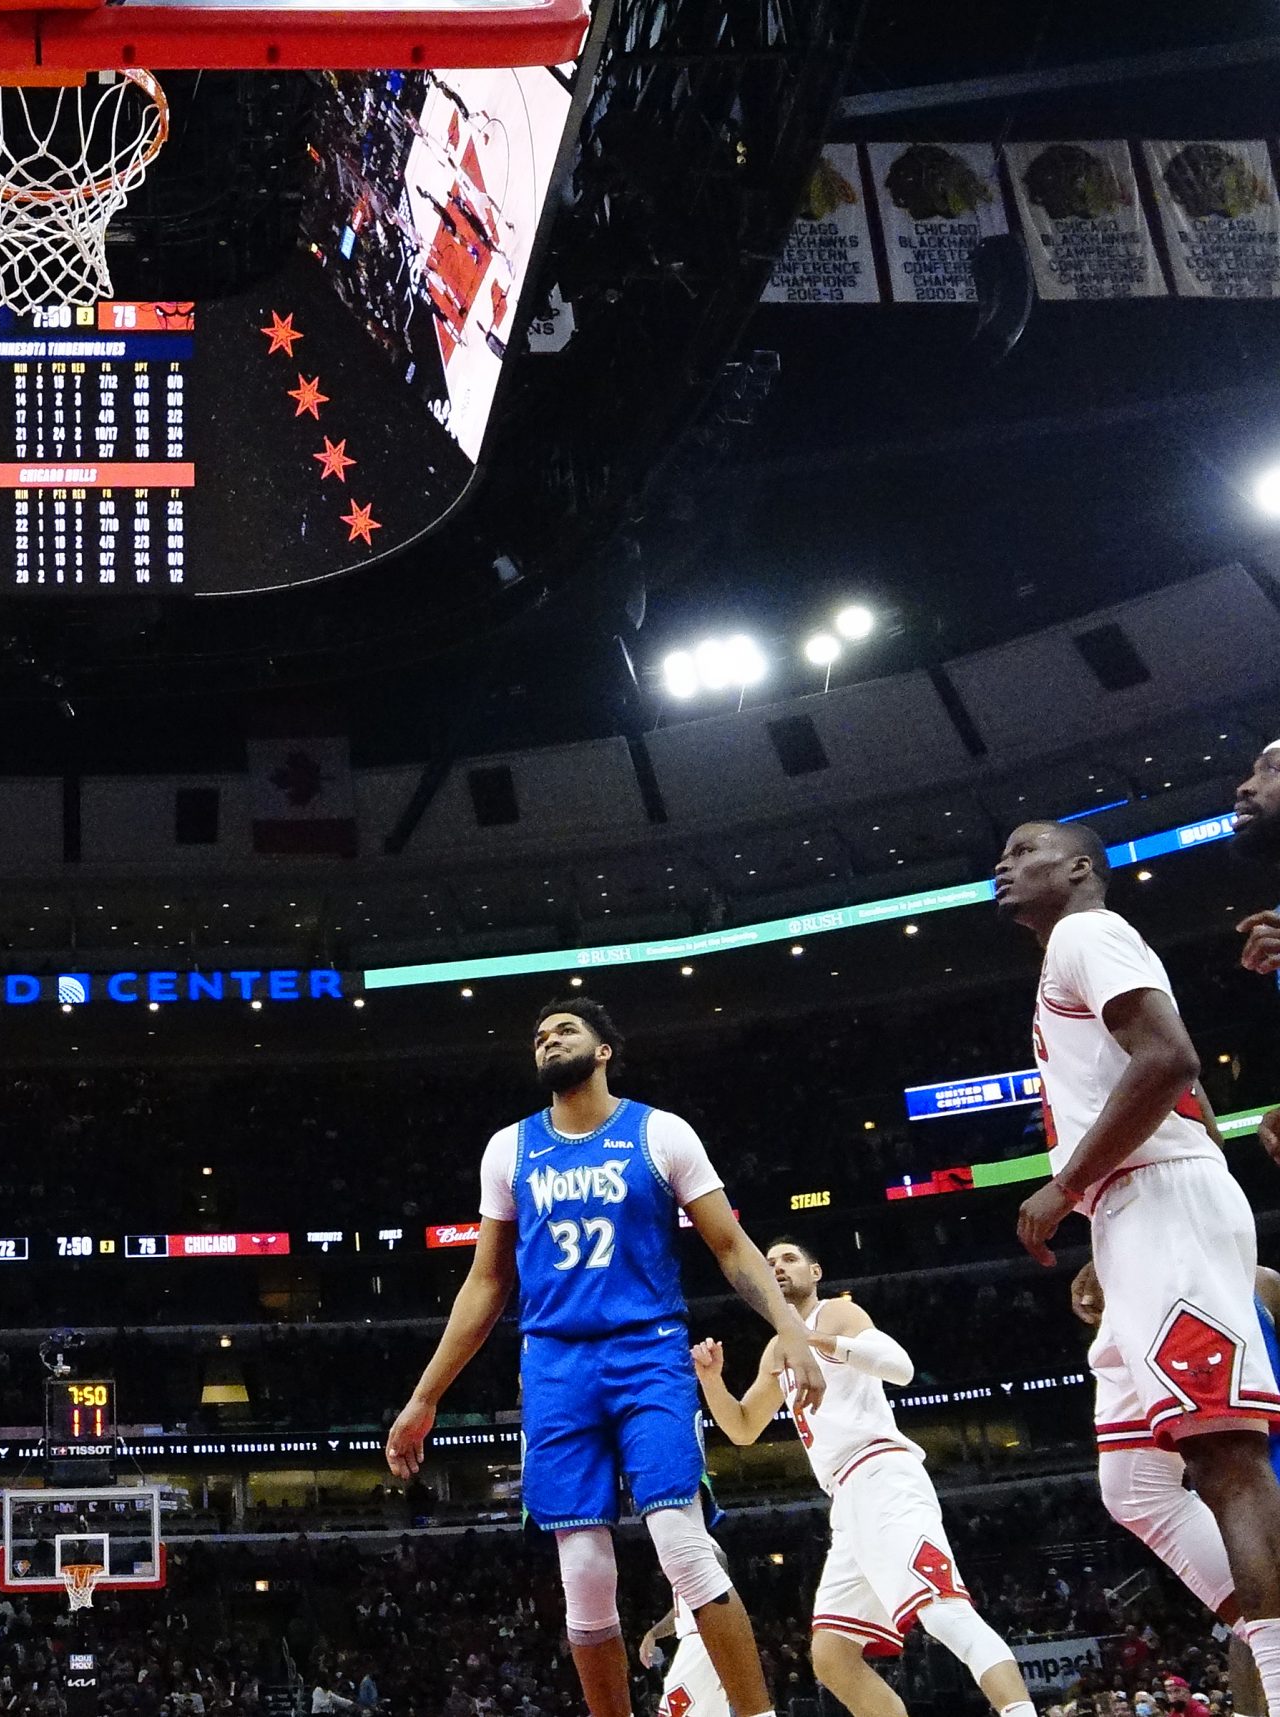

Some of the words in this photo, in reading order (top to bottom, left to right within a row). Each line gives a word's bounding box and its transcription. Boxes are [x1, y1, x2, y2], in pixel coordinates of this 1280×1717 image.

[32, 306, 71, 328] 7:50
[113, 306, 137, 327] 75
[16, 375, 26, 389] 21
[36, 375, 43, 389] 2
[74, 375, 81, 389] 7
[16, 427, 26, 440] 21
[53, 427, 65, 440] 24
[37, 444, 43, 457] 2
[56, 444, 62, 457] 7
[75, 444, 80, 457] 1
[19, 469, 64, 483] CHICAGO
[1180, 824, 1218, 845] BUD
[803, 912, 843, 932] RUSH
[591, 947, 632, 964] RUSH
[107, 970, 344, 1000] CENTER
[935, 1086, 982, 1100] UNITED
[937, 1094, 984, 1109] CENTER
[791, 1192, 831, 1210] STEALS
[56, 1236, 93, 1256] 7:50
[138, 1238, 156, 1255] 75
[184, 1236, 237, 1254] CHICAGO
[547, 1217, 615, 1271] 32
[68, 1385, 108, 1406] 7:50
[73, 1408, 102, 1438] 11
[68, 1445, 113, 1456] TISSOT
[1019, 1649, 1096, 1684] mpact
